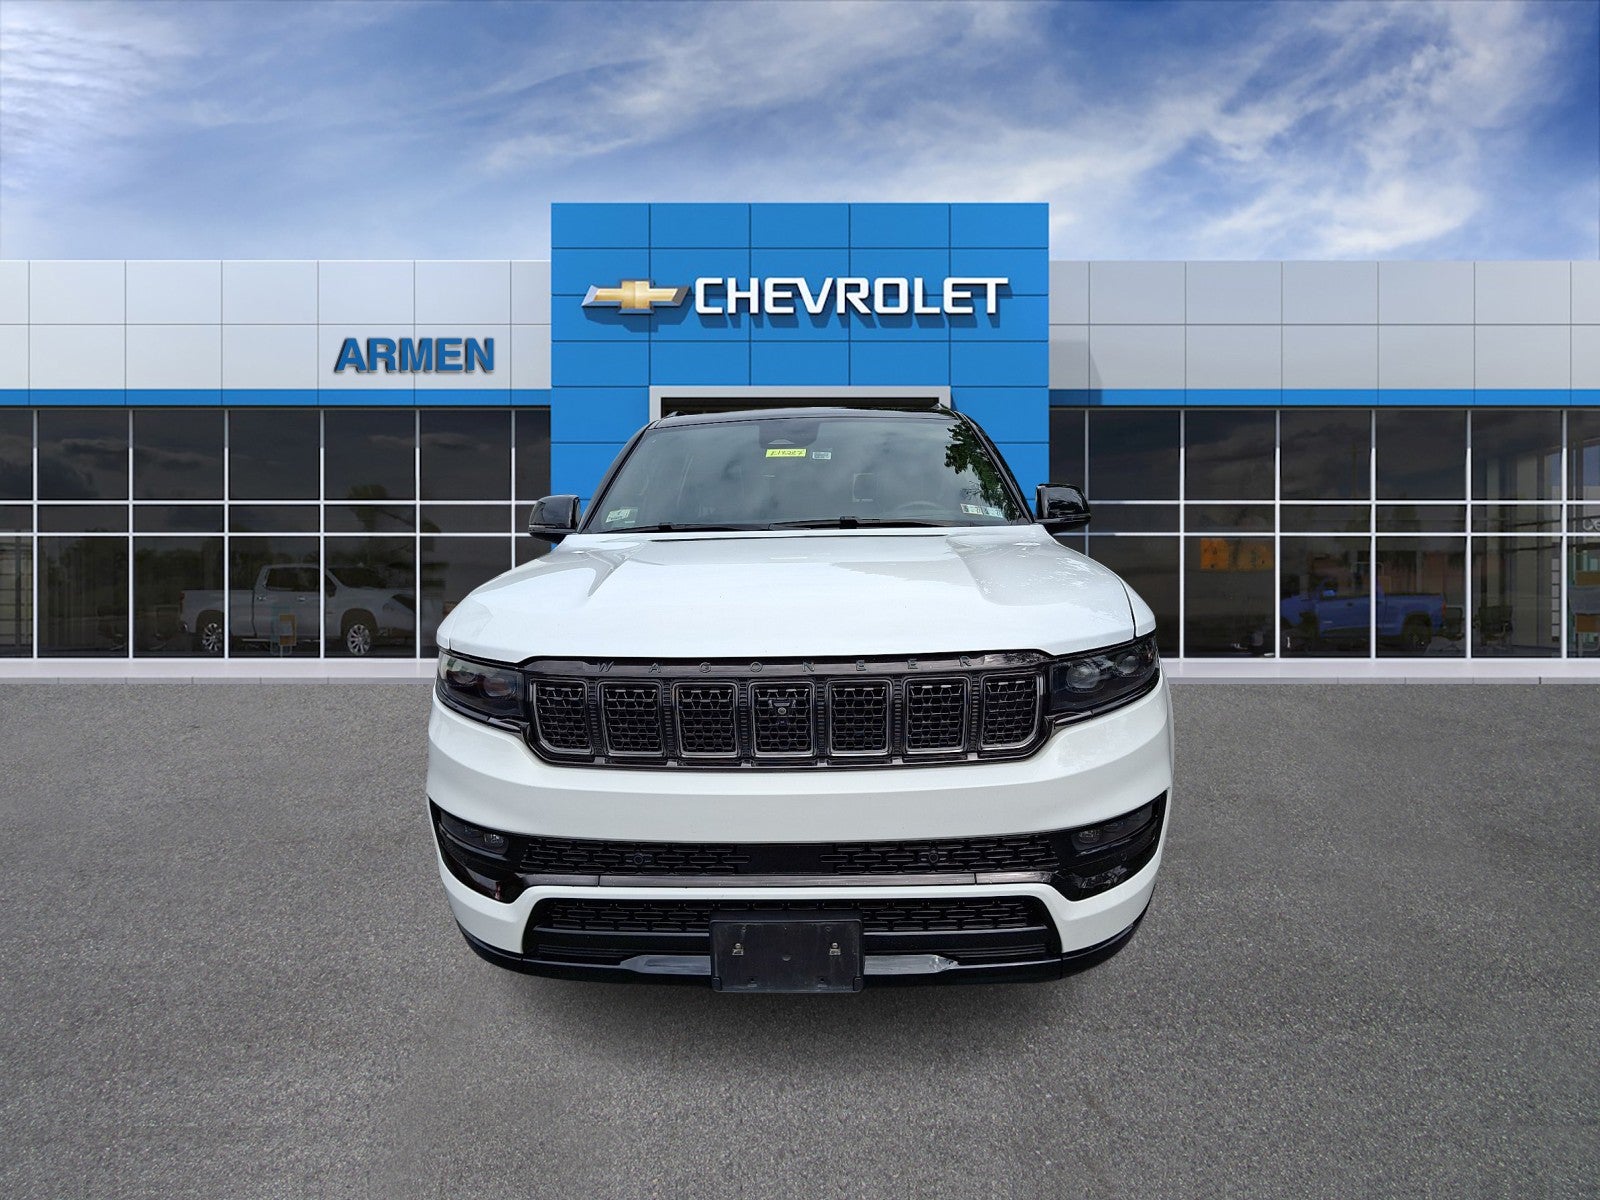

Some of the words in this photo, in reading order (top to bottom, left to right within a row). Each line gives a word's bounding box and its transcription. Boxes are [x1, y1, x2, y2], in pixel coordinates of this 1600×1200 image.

[695, 277, 1009, 315] CHEVROLET
[334, 337, 495, 374] ARMEN
[598, 655, 972, 674] WAGONEER
